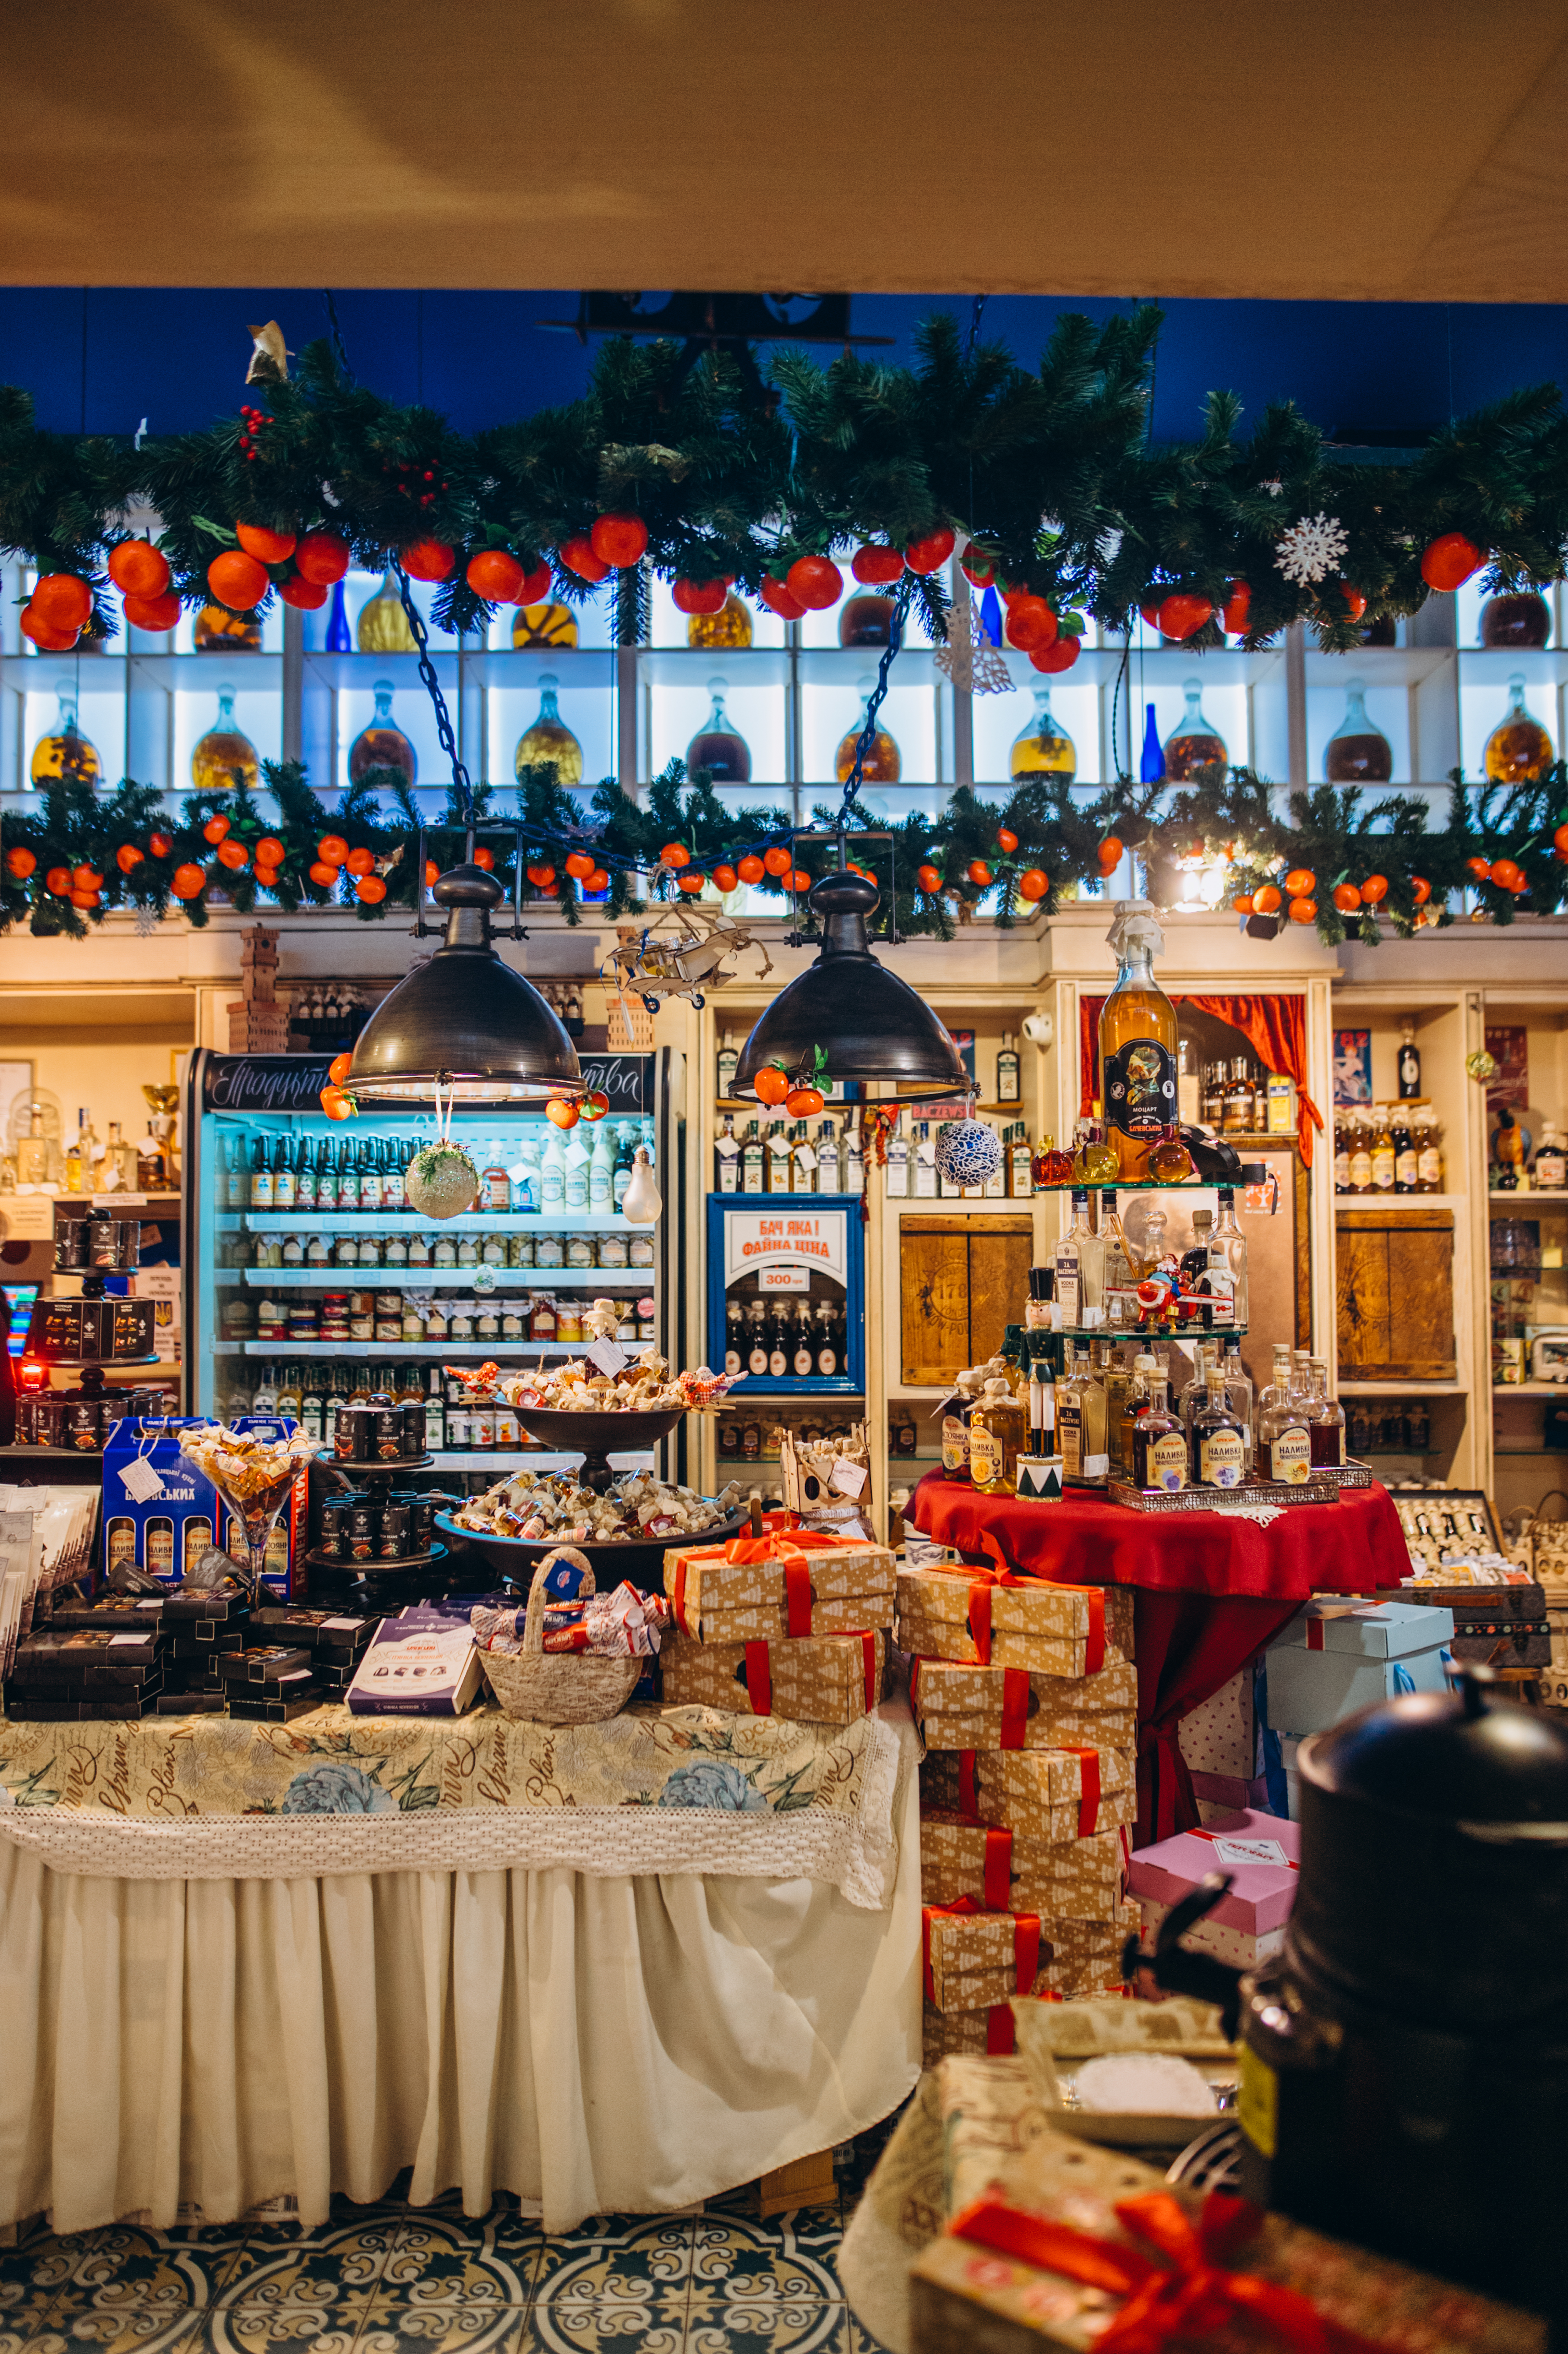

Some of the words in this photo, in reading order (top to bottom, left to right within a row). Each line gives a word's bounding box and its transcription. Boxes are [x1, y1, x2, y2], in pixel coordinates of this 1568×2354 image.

[213, 1059, 333, 1108] Продукт
[912, 1105, 974, 1118] BACZEWSKI
[760, 1220, 783, 1236] БАЧ
[742, 1237, 792, 1257] ФАЙНА
[794, 1240, 830, 1258] ЦІНА
[766, 1274, 791, 1285] 300
[1155, 1450, 1185, 1459] НАЛИВКА
[181, 1473, 197, 1485] кухні
[296, 1472, 306, 1586] БАЧЕВСЬКИ
